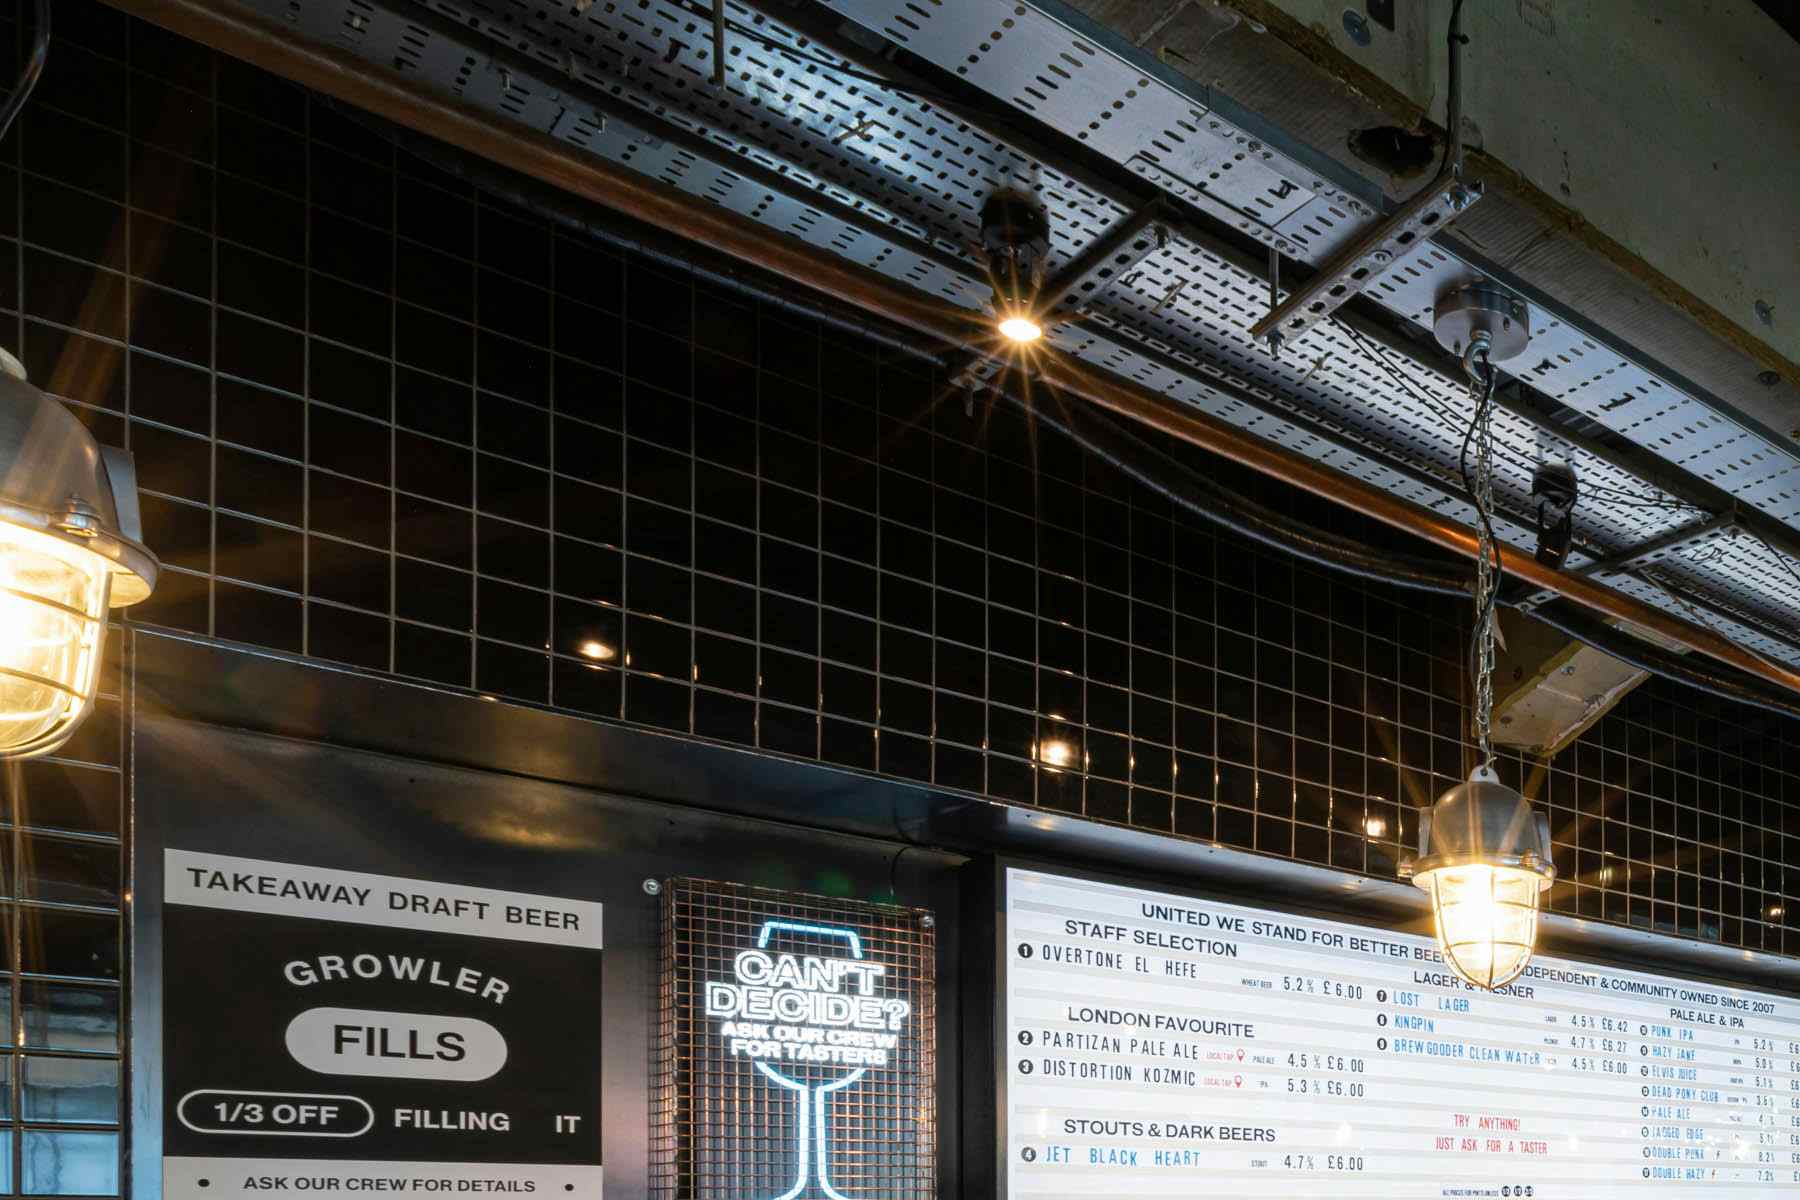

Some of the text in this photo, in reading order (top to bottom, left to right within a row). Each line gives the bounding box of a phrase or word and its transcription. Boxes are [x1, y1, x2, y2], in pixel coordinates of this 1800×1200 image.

[187, 867, 580, 931] TAKEAWAY DRAFT BEER
[1065, 920, 1238, 957] STAFF SELECTION
[1042, 944, 1123, 970] OVERTONE
[1135, 956, 1149, 973] EL
[1166, 960, 1197, 978] HEFE
[1142, 903, 1210, 927] UNITED
[1216, 915, 1246, 933] WE
[1252, 921, 1306, 942] STAND
[1312, 931, 1344, 948] FOR
[1350, 937, 1408, 958] BETTER
[1600, 978, 1609, 988] &
[1612, 978, 1677, 999] COMMUNITY
[1680, 990, 1718, 1005] OWNED
[1721, 996, 1748, 1010] SINCE
[1752, 1001, 1775, 1014] 2007
[283, 953, 510, 1004] GROWLER
[734, 950, 886, 995] CAN'T
[1414, 970, 1460, 990] LAGER
[705, 981, 910, 1030] DECIDE?
[1393, 991, 1419, 1007] LOST
[1439, 997, 1470, 1012] LAGER
[1068, 1006, 1255, 1038] LONDON FAVOURITE
[1394, 1014, 1435, 1033] KINGPIN
[1670, 1008, 1744, 1028] PALE ALE & IPA
[333, 1024, 466, 1062] FILLS
[721, 1021, 897, 1048] ASK OUR CREW
[1043, 1031, 1120, 1053] PARTIZAN
[1130, 1038, 1165, 1057] PALE
[1174, 1043, 1199, 1060] ALE
[731, 1038, 888, 1065] FOR TASTERS
[1469, 1046, 1500, 1062] CLEAN
[1602, 1059, 1627, 1075] £6.00
[1043, 1059, 1132, 1081] DISTORTION
[1144, 1068, 1196, 1086] KOZMIC
[214, 1102, 339, 1125] 1/3 OFF
[394, 1109, 581, 1133] FILLING IT
[1454, 1114, 1470, 1127] TRY
[1064, 1118, 1276, 1142] STOUTS & DARK BEERS
[1046, 1146, 1072, 1164] JET
[1090, 1148, 1137, 1166] BLACK
[1155, 1151, 1200, 1167] HEART
[1436, 1136, 1548, 1154] JUST ASK FOR A TASTER
[244, 1176, 536, 1193] ASK OUR CREW FOR DETAILS
